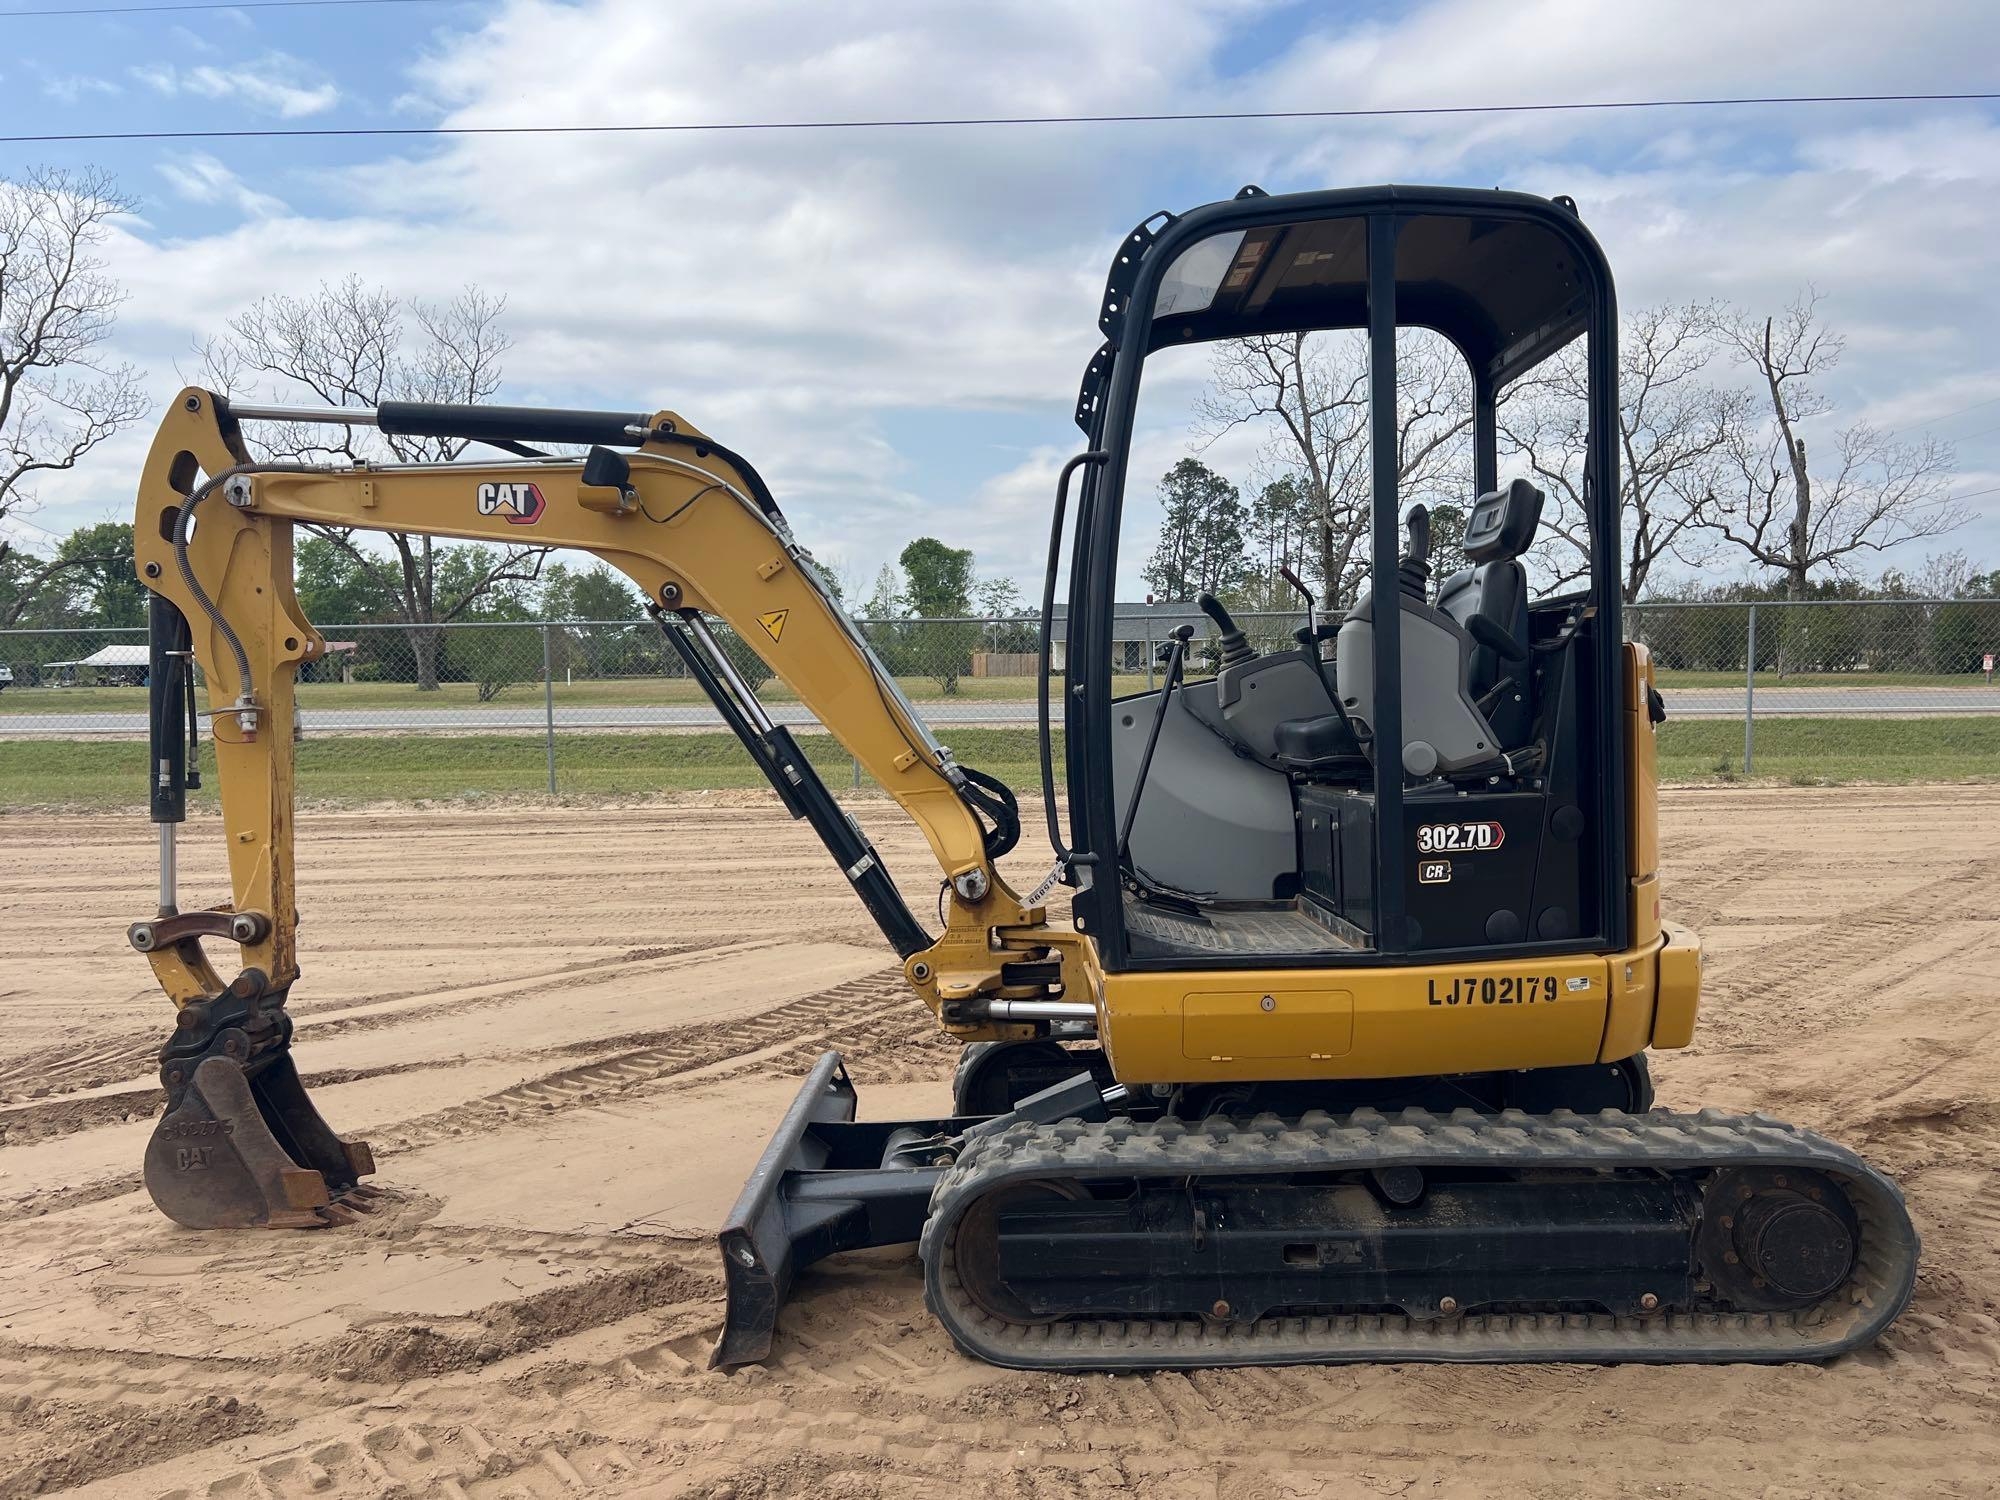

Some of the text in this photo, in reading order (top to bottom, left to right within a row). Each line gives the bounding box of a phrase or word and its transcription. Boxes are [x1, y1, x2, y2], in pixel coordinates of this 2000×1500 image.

[478, 483, 529, 515] CAT
[1419, 824, 1491, 850] 302.7D
[1425, 865, 1444, 879] CR
[1428, 976, 1557, 1006] LJ702179
[177, 1146, 214, 1171] CAT
